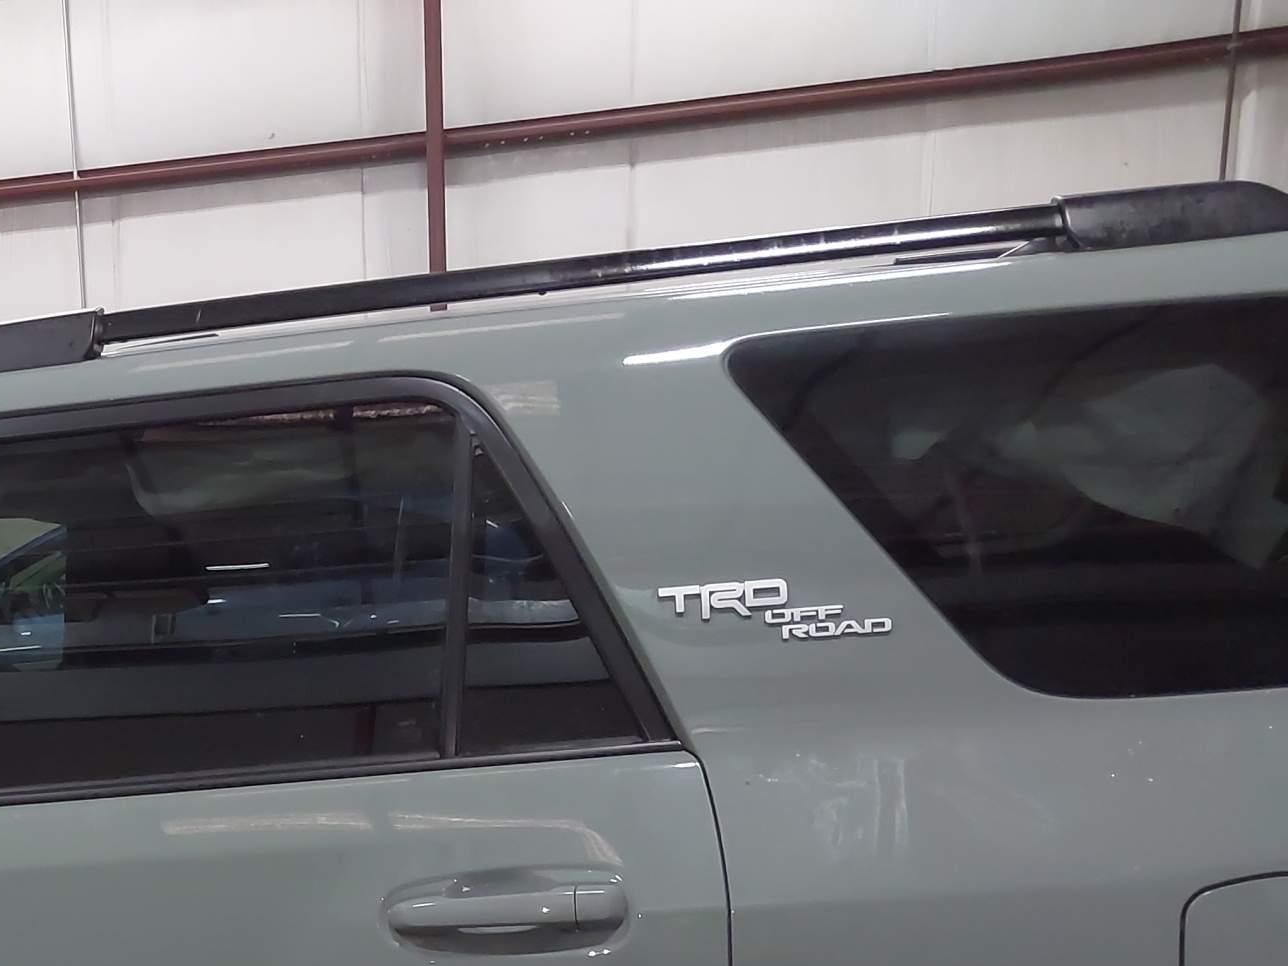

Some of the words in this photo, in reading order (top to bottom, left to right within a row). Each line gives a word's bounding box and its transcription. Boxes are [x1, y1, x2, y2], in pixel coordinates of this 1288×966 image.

[657, 578, 788, 621] TRD
[764, 605, 844, 624] OFF
[781, 617, 892, 640] ROAD
